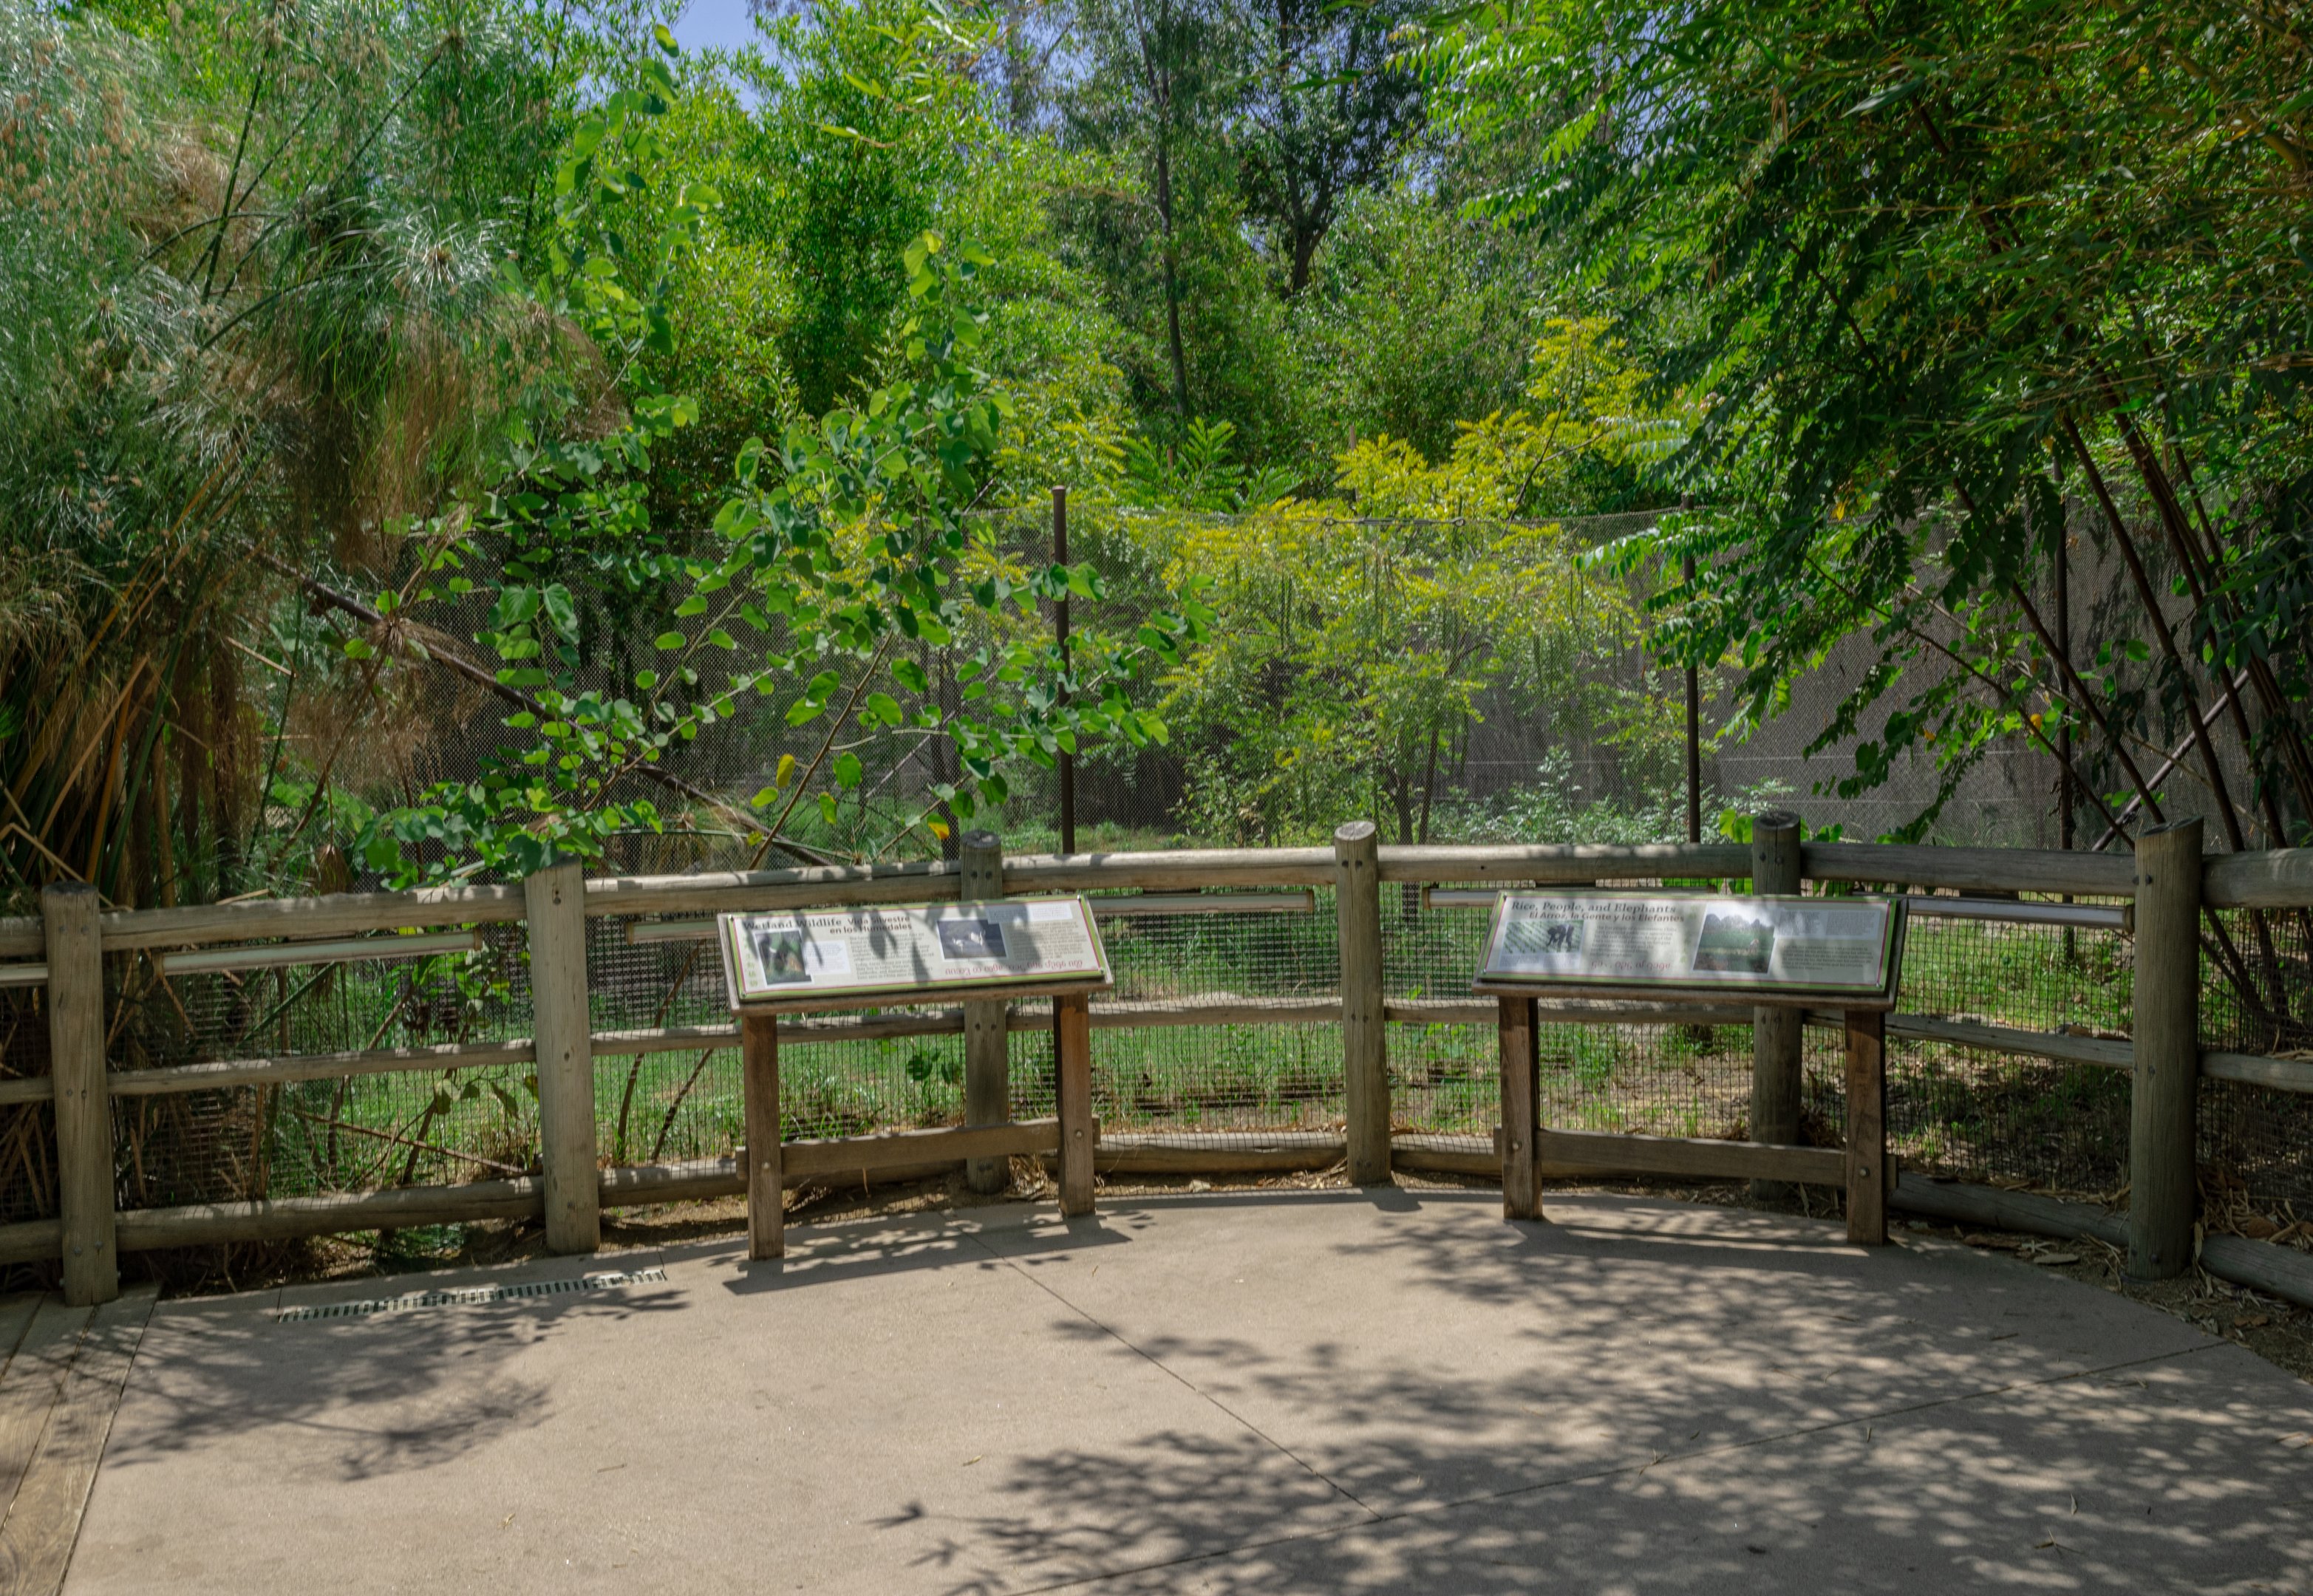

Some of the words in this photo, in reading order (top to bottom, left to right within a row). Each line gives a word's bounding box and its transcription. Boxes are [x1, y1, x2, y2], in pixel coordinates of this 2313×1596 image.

[1511, 901, 1538, 912] Rice,
[1542, 902, 1584, 913] People,
[1587, 904, 1611, 912] and
[1615, 903, 1676, 915] Elephants
[848, 916, 868, 924] Vida
[1540, 911, 1568, 919] Arroz,
[1582, 912, 1611, 920] Gente
[1622, 913, 1635, 921] los
[1638, 913, 1684, 922] Elefantes
[743, 920, 793, 930] Wetland
[795, 918, 842, 928] Wildlife
[843, 926, 857, 934] los
[859, 923, 912, 932] Humedales
